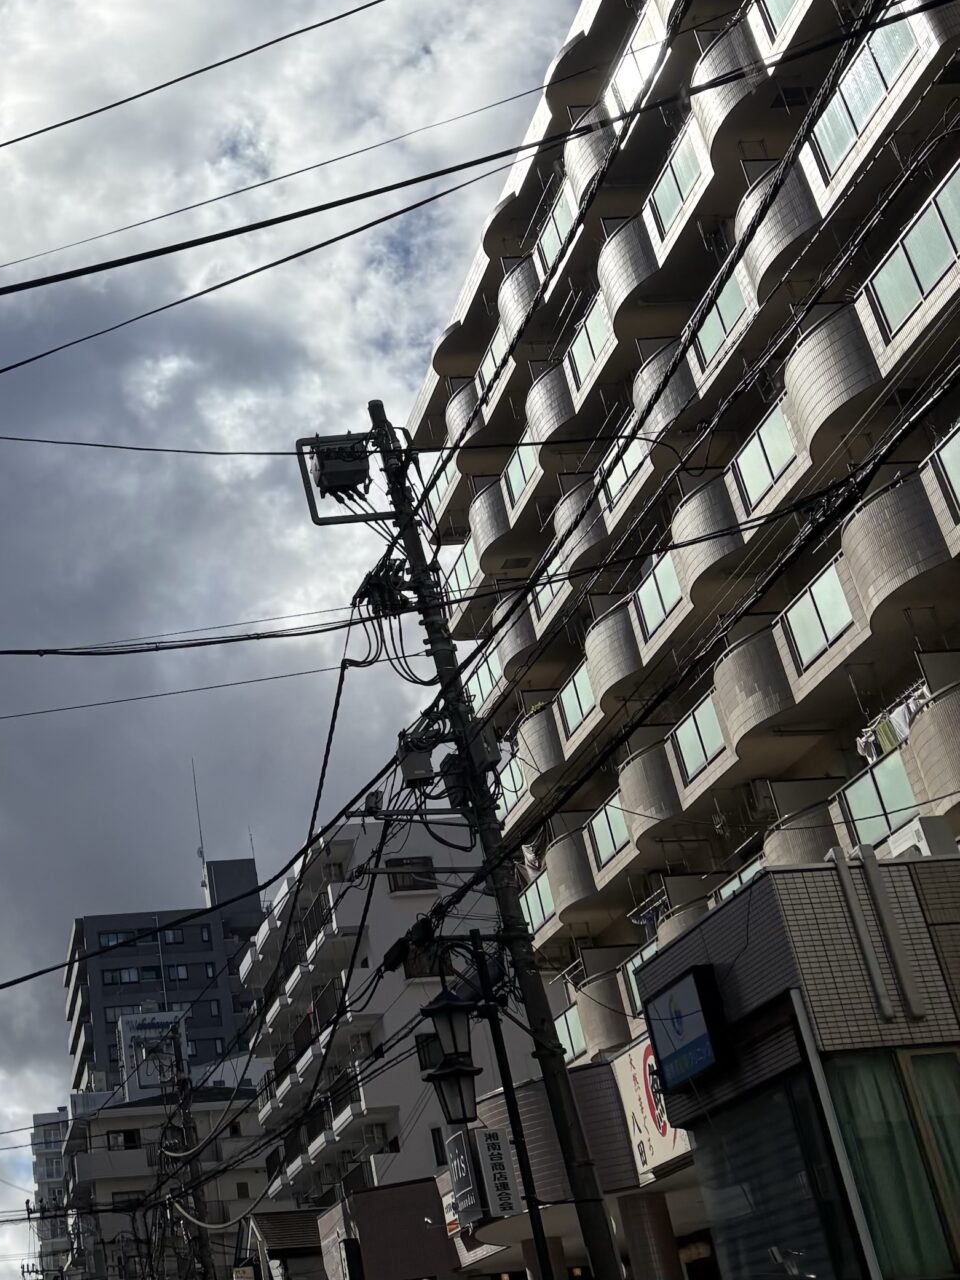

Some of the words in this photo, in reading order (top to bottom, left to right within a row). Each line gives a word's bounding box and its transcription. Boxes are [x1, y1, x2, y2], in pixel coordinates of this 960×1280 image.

[451, 1148, 467, 1183] iris
[484, 1131, 514, 1212] 湘南台商店連合会
